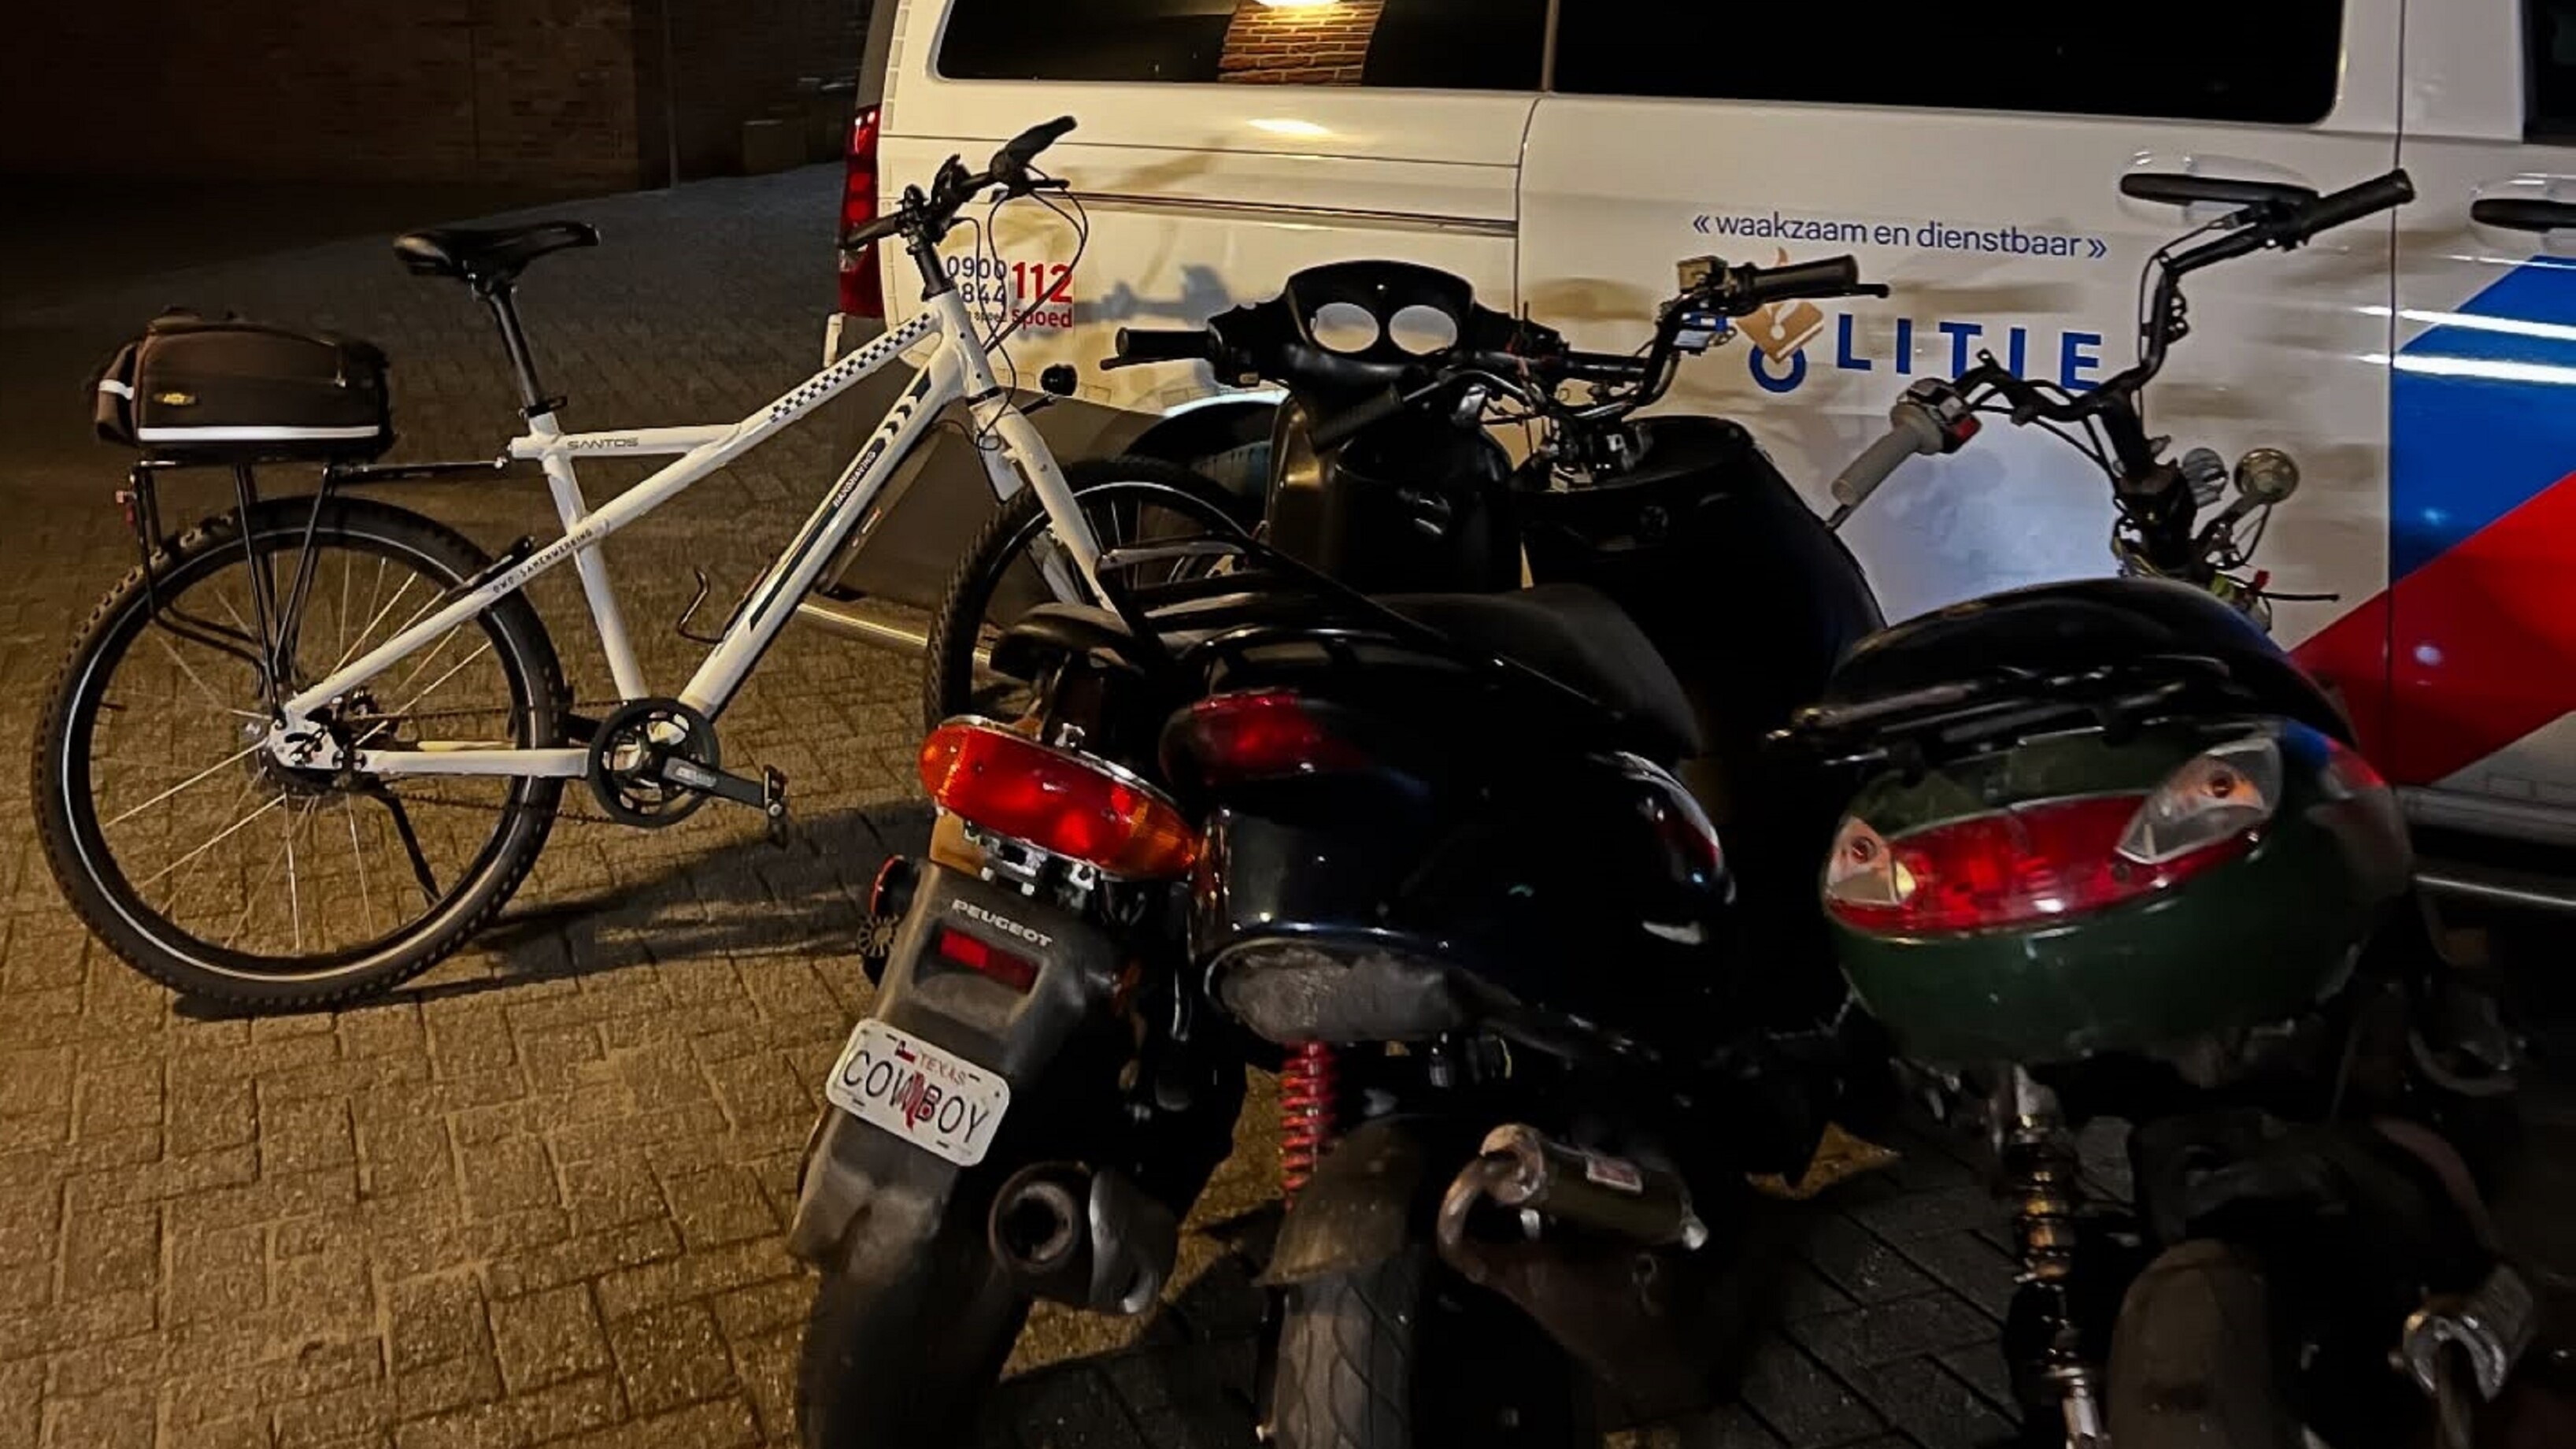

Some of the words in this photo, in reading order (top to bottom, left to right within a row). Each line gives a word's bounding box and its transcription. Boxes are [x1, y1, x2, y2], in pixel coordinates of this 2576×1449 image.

[1715, 210, 1867, 243] waakzaam
[1875, 225, 1910, 246] en
[1916, 220, 2082, 257] dienstbaar
[946, 255, 1008, 280] 0900
[1012, 261, 1073, 304] 112
[958, 282, 1007, 306] 844
[1690, 313, 2102, 392] OLITIE
[567, 437, 639, 451] SANTOS
[951, 899, 1053, 947] PEUGEOT
[918, 1051, 967, 1087] TEXAS
[842, 1049, 990, 1143] COWBOY
